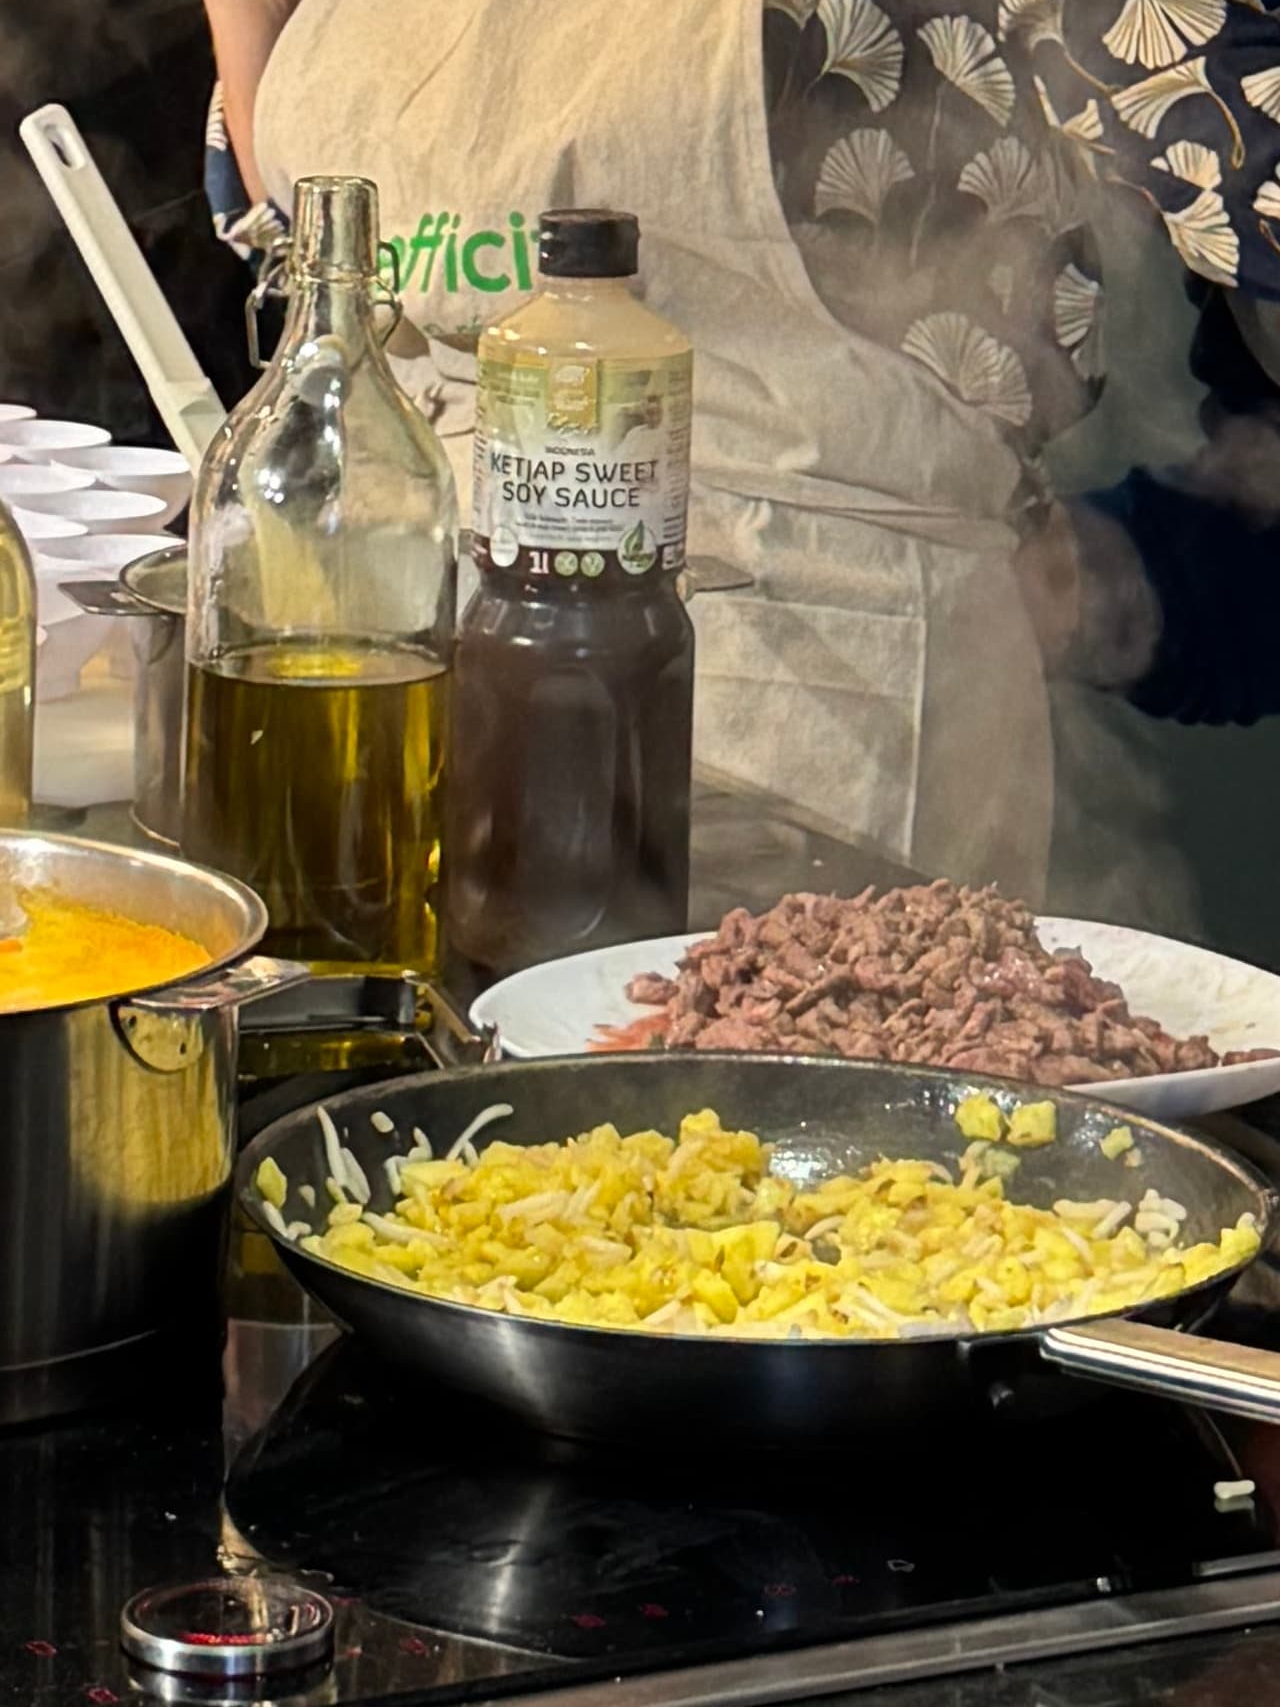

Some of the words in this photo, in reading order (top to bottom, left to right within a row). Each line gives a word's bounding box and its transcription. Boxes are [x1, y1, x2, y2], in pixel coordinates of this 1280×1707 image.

[491, 452, 565, 483] KETJAP
[575, 459, 658, 483] SWEET
[502, 481, 547, 505] SOY
[554, 487, 641, 508] SAUCE
